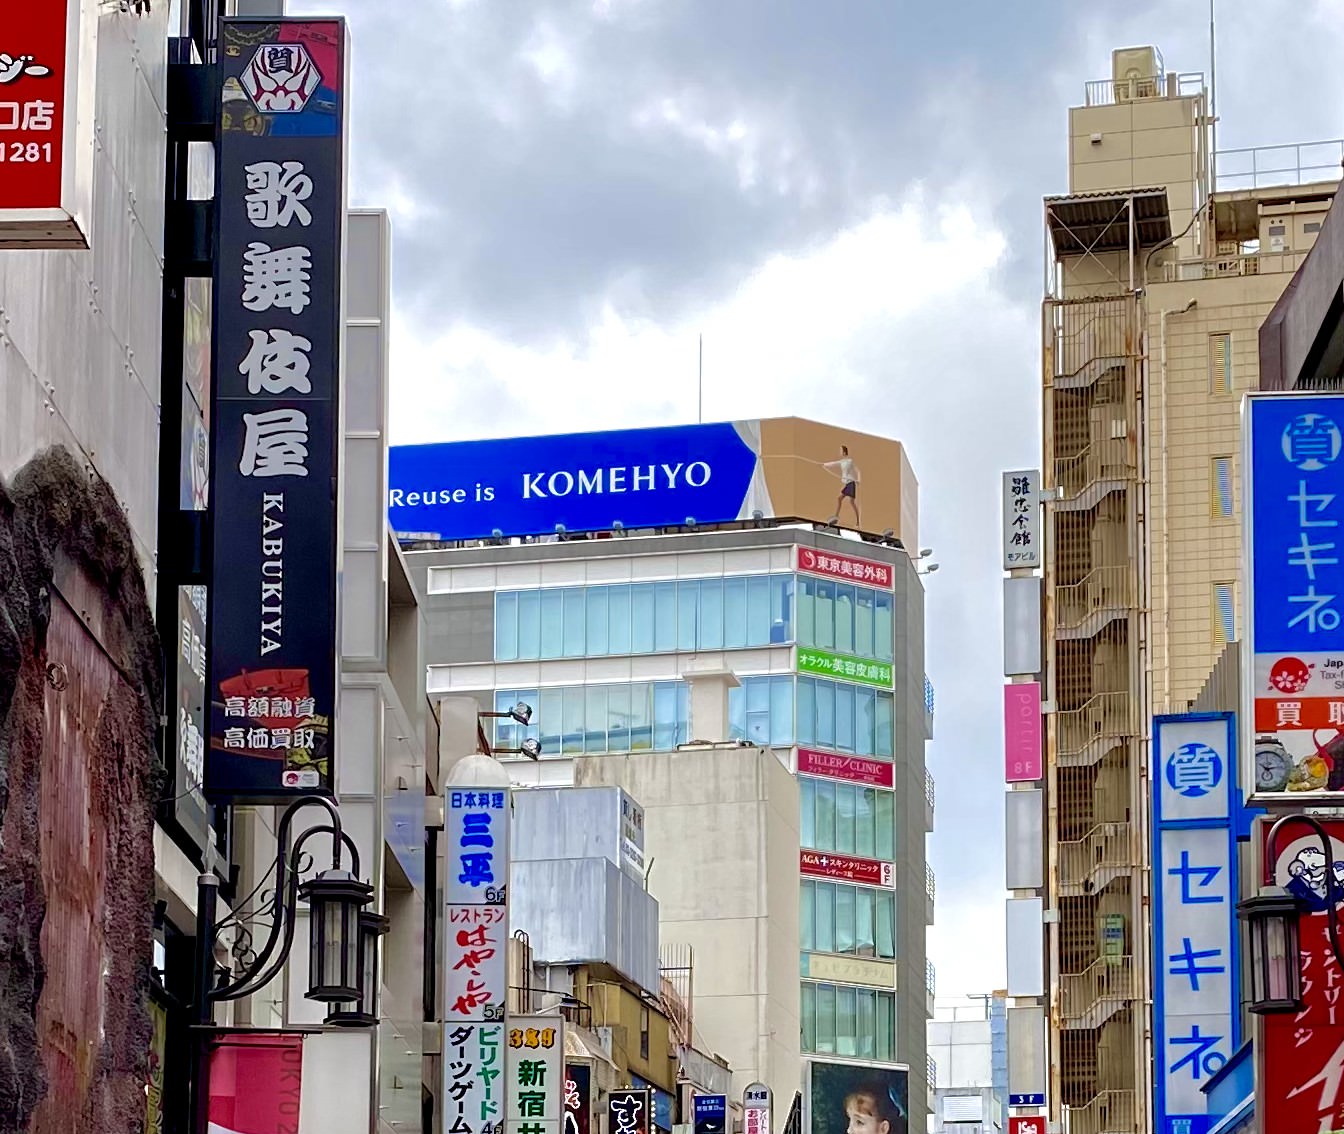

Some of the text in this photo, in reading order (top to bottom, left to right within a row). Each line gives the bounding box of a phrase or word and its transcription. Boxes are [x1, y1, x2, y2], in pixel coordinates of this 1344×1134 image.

[239, 159, 313, 478] 歌舞伎屋
[389, 460, 712, 507] Reuse is KOMEHYO
[816, 554, 888, 583] 東京美容外科
[1286, 479, 1341, 633] セキネ
[260, 491, 285, 657] KABUKIYA
[224, 696, 316, 719] 高額融資
[223, 727, 316, 750] 高価買取
[1013, 762, 1033, 774] 8F
[450, 792, 505, 810] 日本料理
[457, 811, 495, 888] 三平
[484, 887, 506, 902] 6F
[450, 908, 505, 924] レストラン
[1167, 849, 1228, 1080] セキネ
[483, 1003, 505, 1020] 5F
[475, 1026, 500, 1121] ビリヤード
